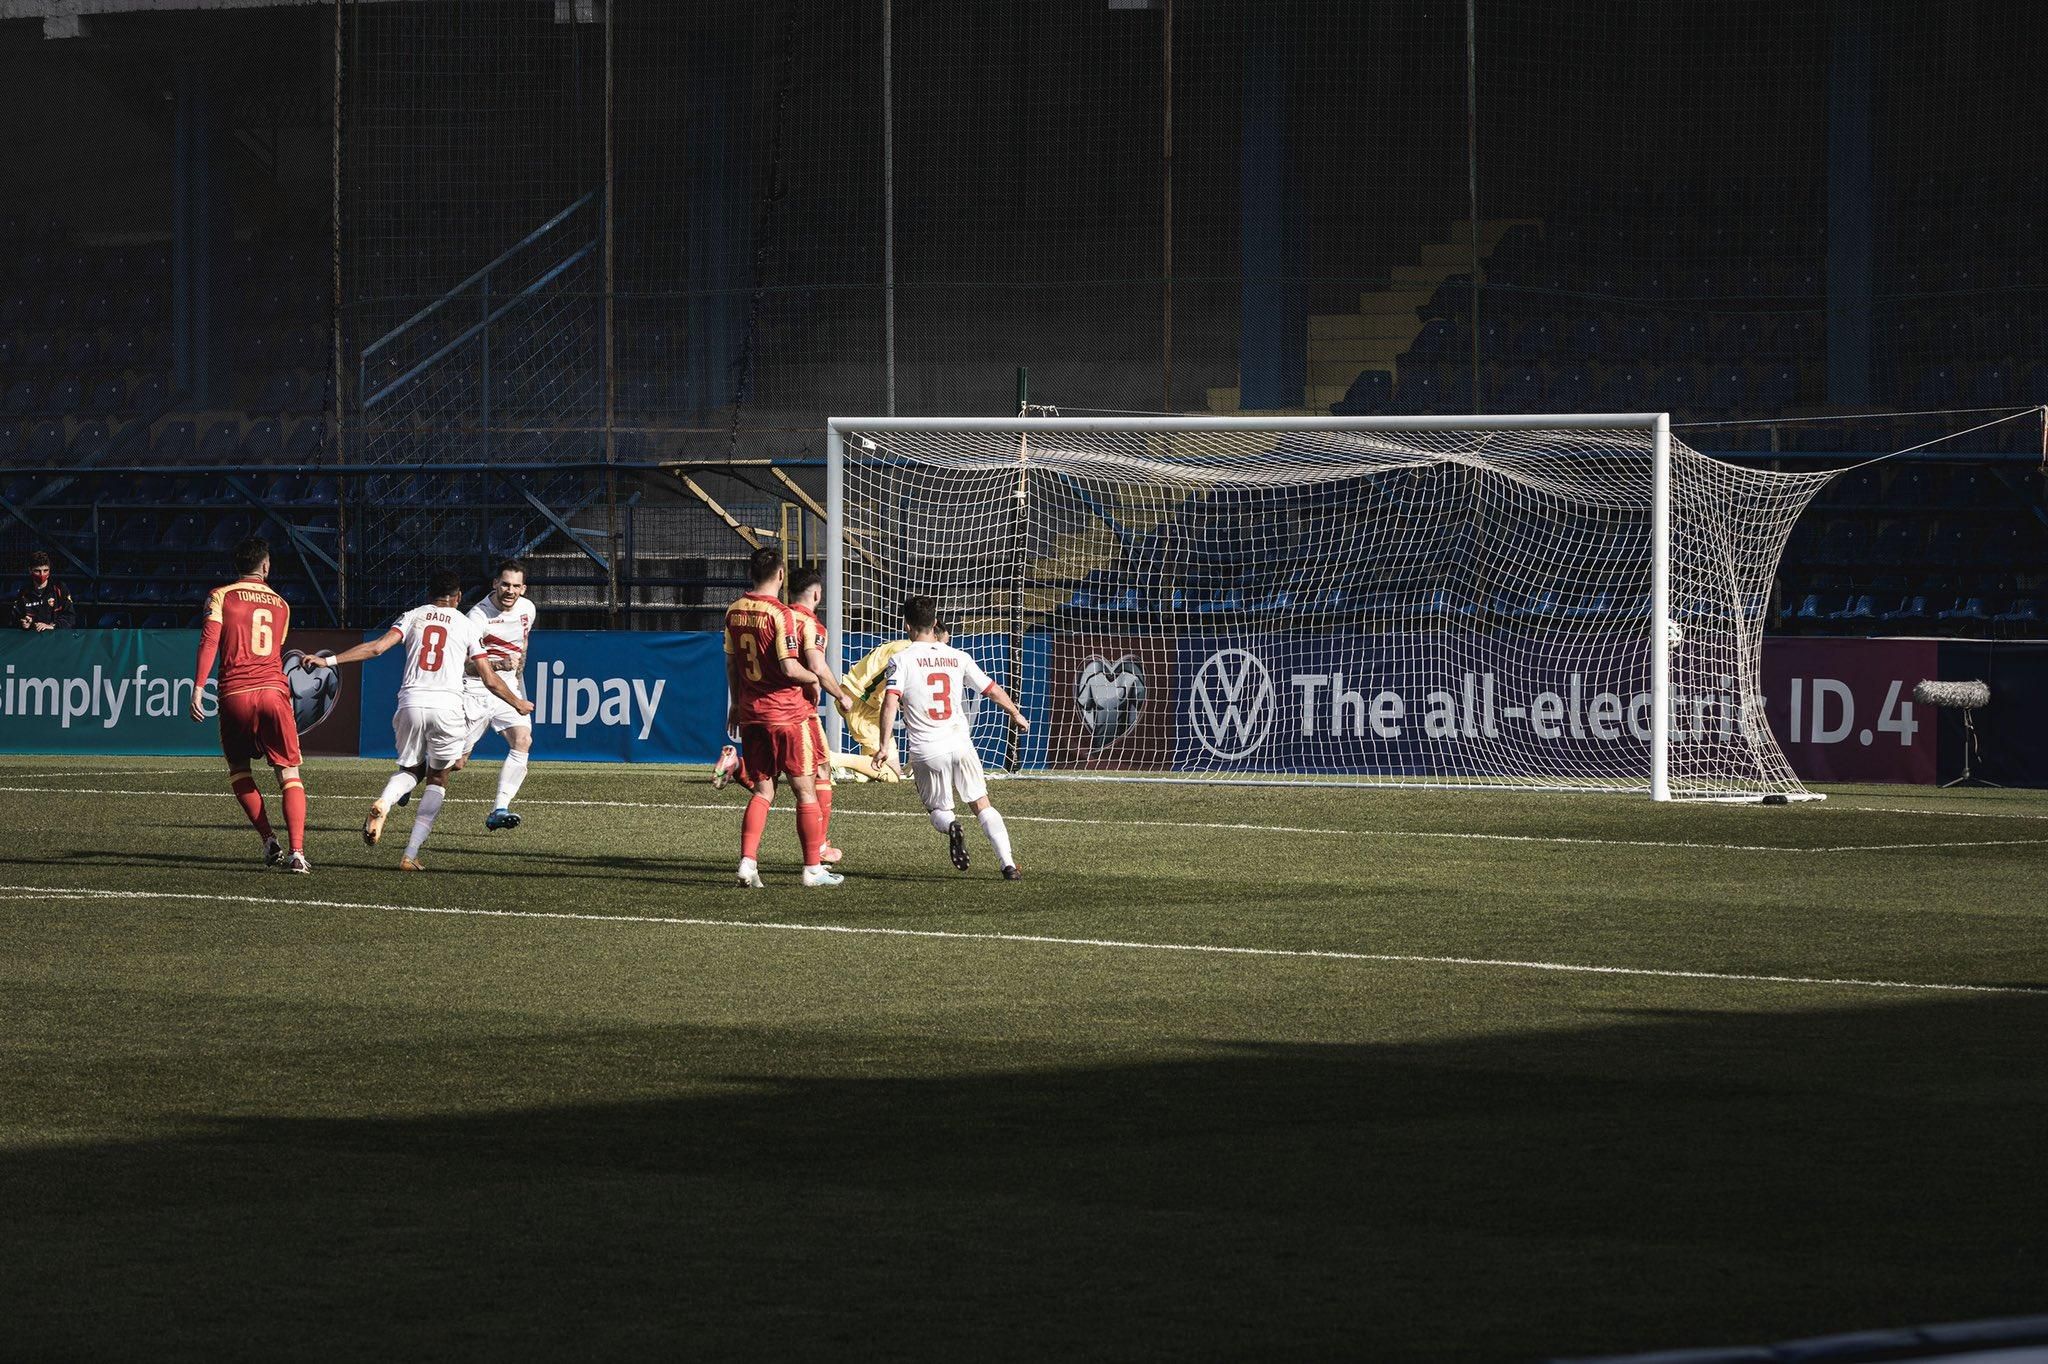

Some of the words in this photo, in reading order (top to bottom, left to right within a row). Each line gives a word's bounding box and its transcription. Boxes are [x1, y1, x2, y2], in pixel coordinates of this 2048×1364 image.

[252, 608, 273, 657] 6
[425, 612, 452, 625] BADR
[418, 624, 448, 672] 8
[740, 633, 762, 682] 3
[916, 657, 959, 668] VALARINO
[0, 664, 219, 729] implyfans
[519, 659, 667, 740] lipay
[927, 672, 952, 721] 3
[1291, 672, 1404, 739] The
[1789, 677, 1919, 747] ID.4
